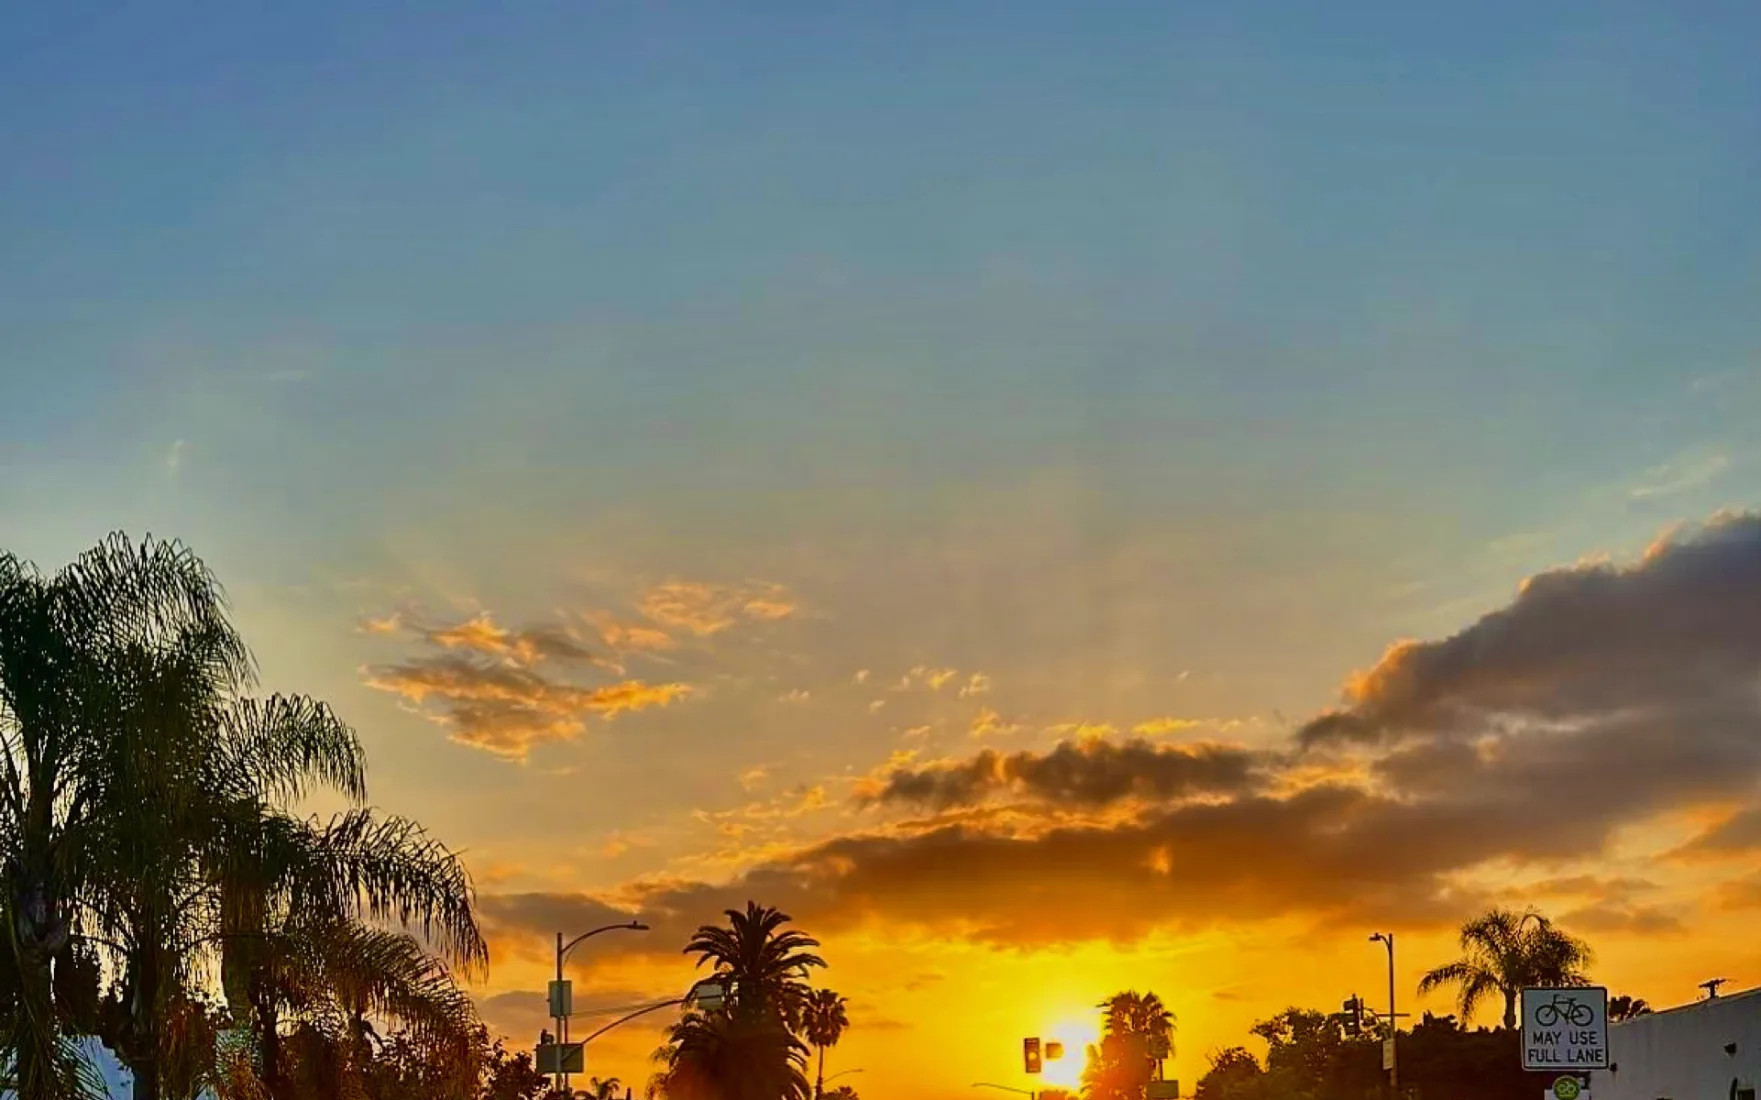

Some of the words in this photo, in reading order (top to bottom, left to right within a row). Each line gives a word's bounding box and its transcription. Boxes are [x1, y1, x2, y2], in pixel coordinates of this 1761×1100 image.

[1533, 1031, 1561, 1045] MAY
[1569, 1031, 1598, 1045] USE
[1528, 1048, 1561, 1062] FULL
[1567, 1048, 1604, 1062] LANE
